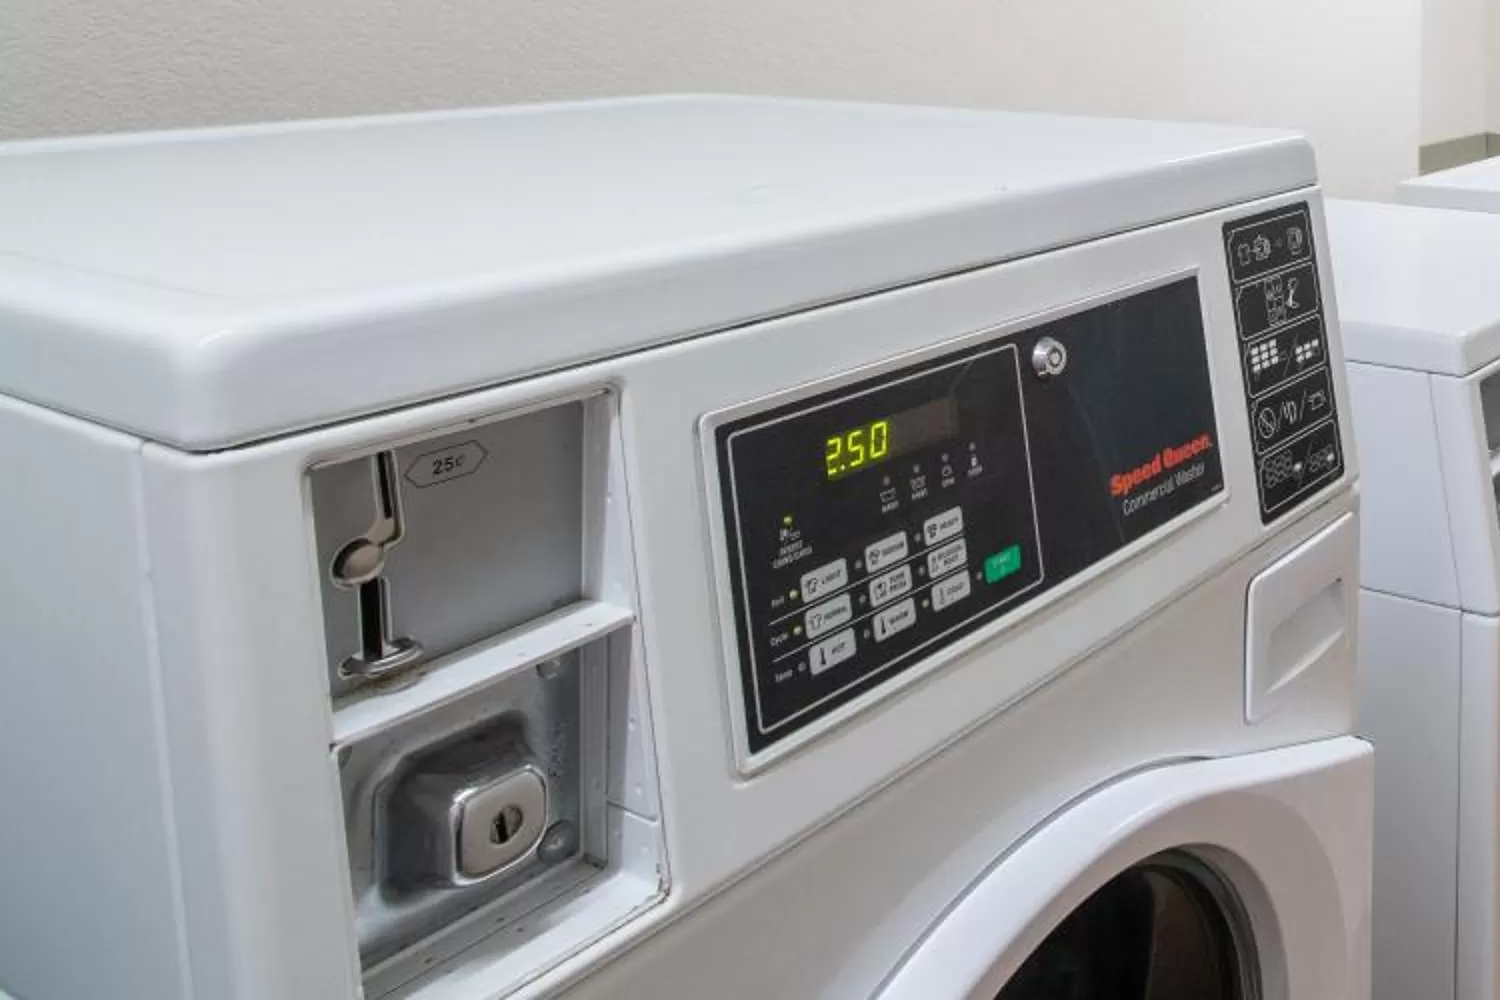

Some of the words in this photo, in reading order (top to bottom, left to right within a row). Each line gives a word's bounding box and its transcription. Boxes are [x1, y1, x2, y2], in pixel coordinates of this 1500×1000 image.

[826, 421, 888, 476] 2.50
[1109, 453, 1163, 496] Speed
[1162, 435, 1210, 469] Queen
[1122, 474, 1175, 516] Commercial
